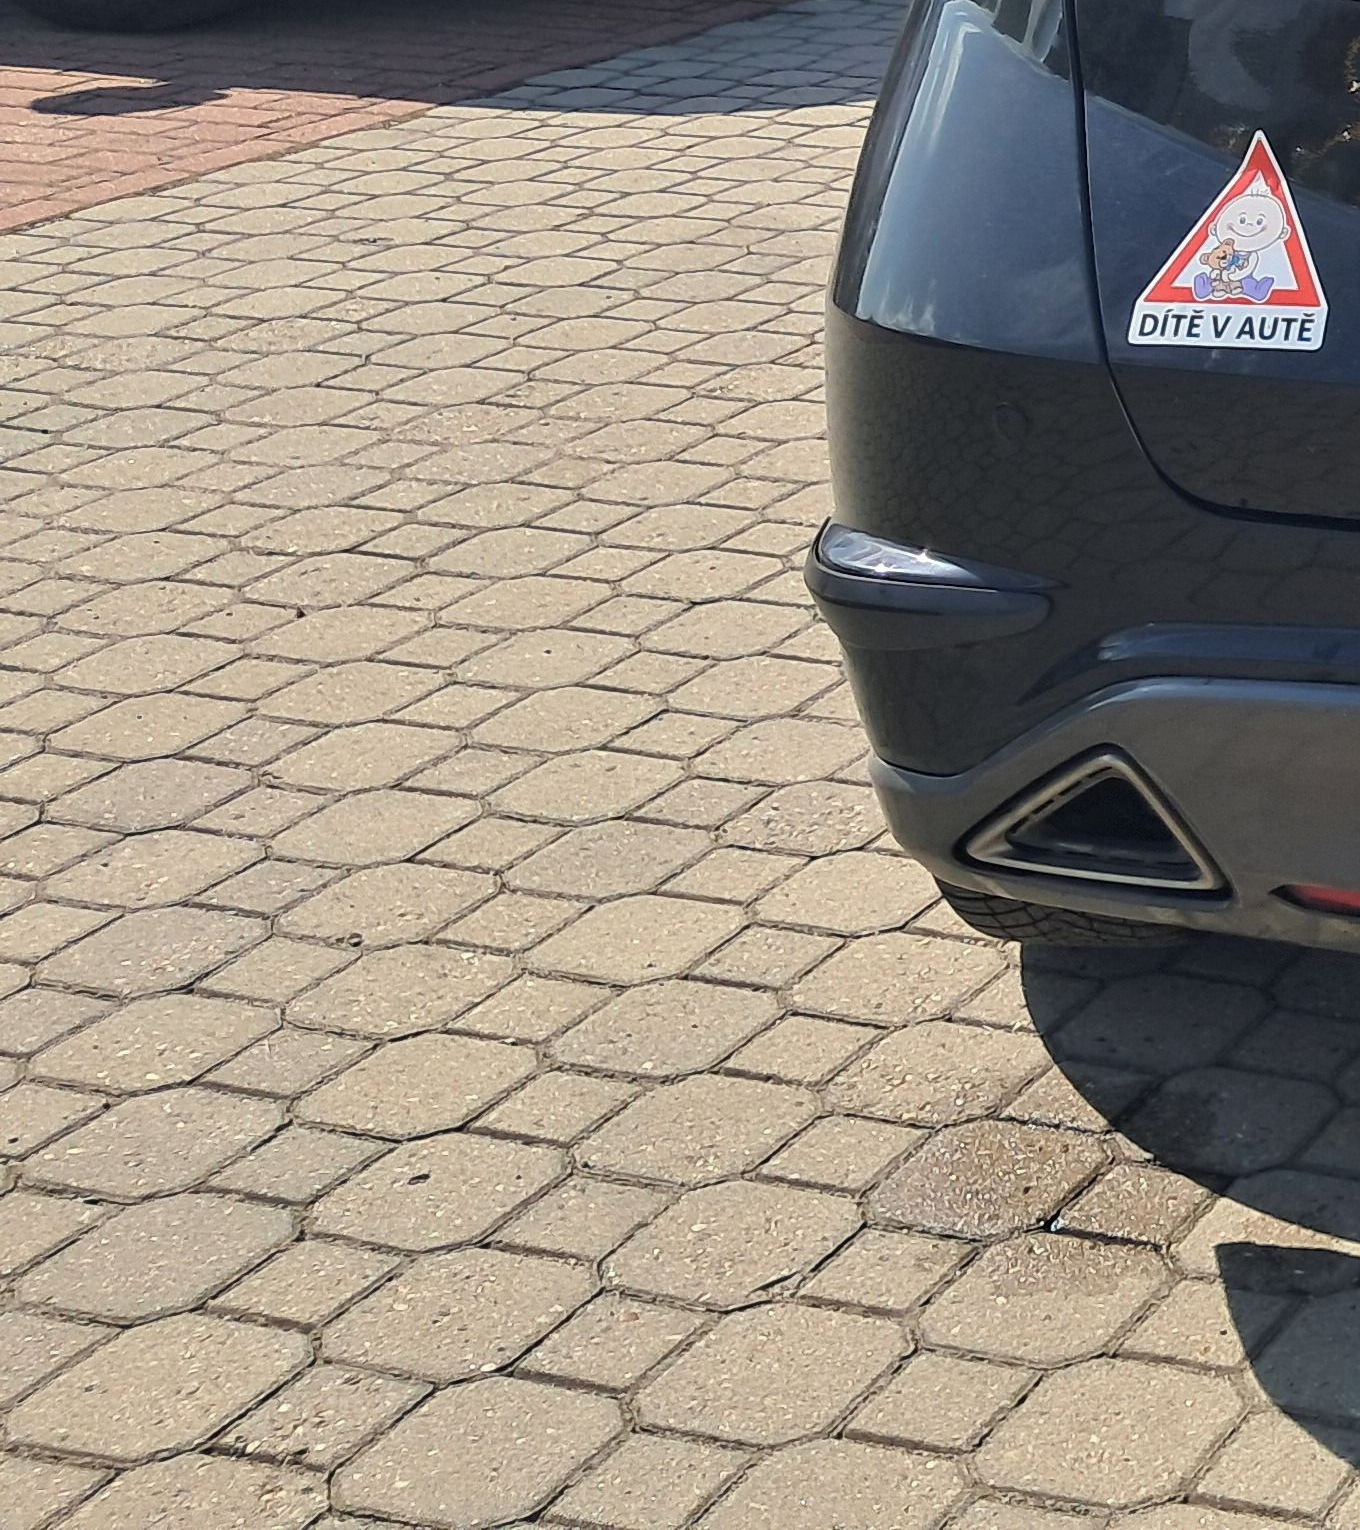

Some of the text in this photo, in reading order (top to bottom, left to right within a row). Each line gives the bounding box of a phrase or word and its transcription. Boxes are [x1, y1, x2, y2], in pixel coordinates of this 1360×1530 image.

[1137, 308, 1316, 342] DÍTĚ V AUTĚ
